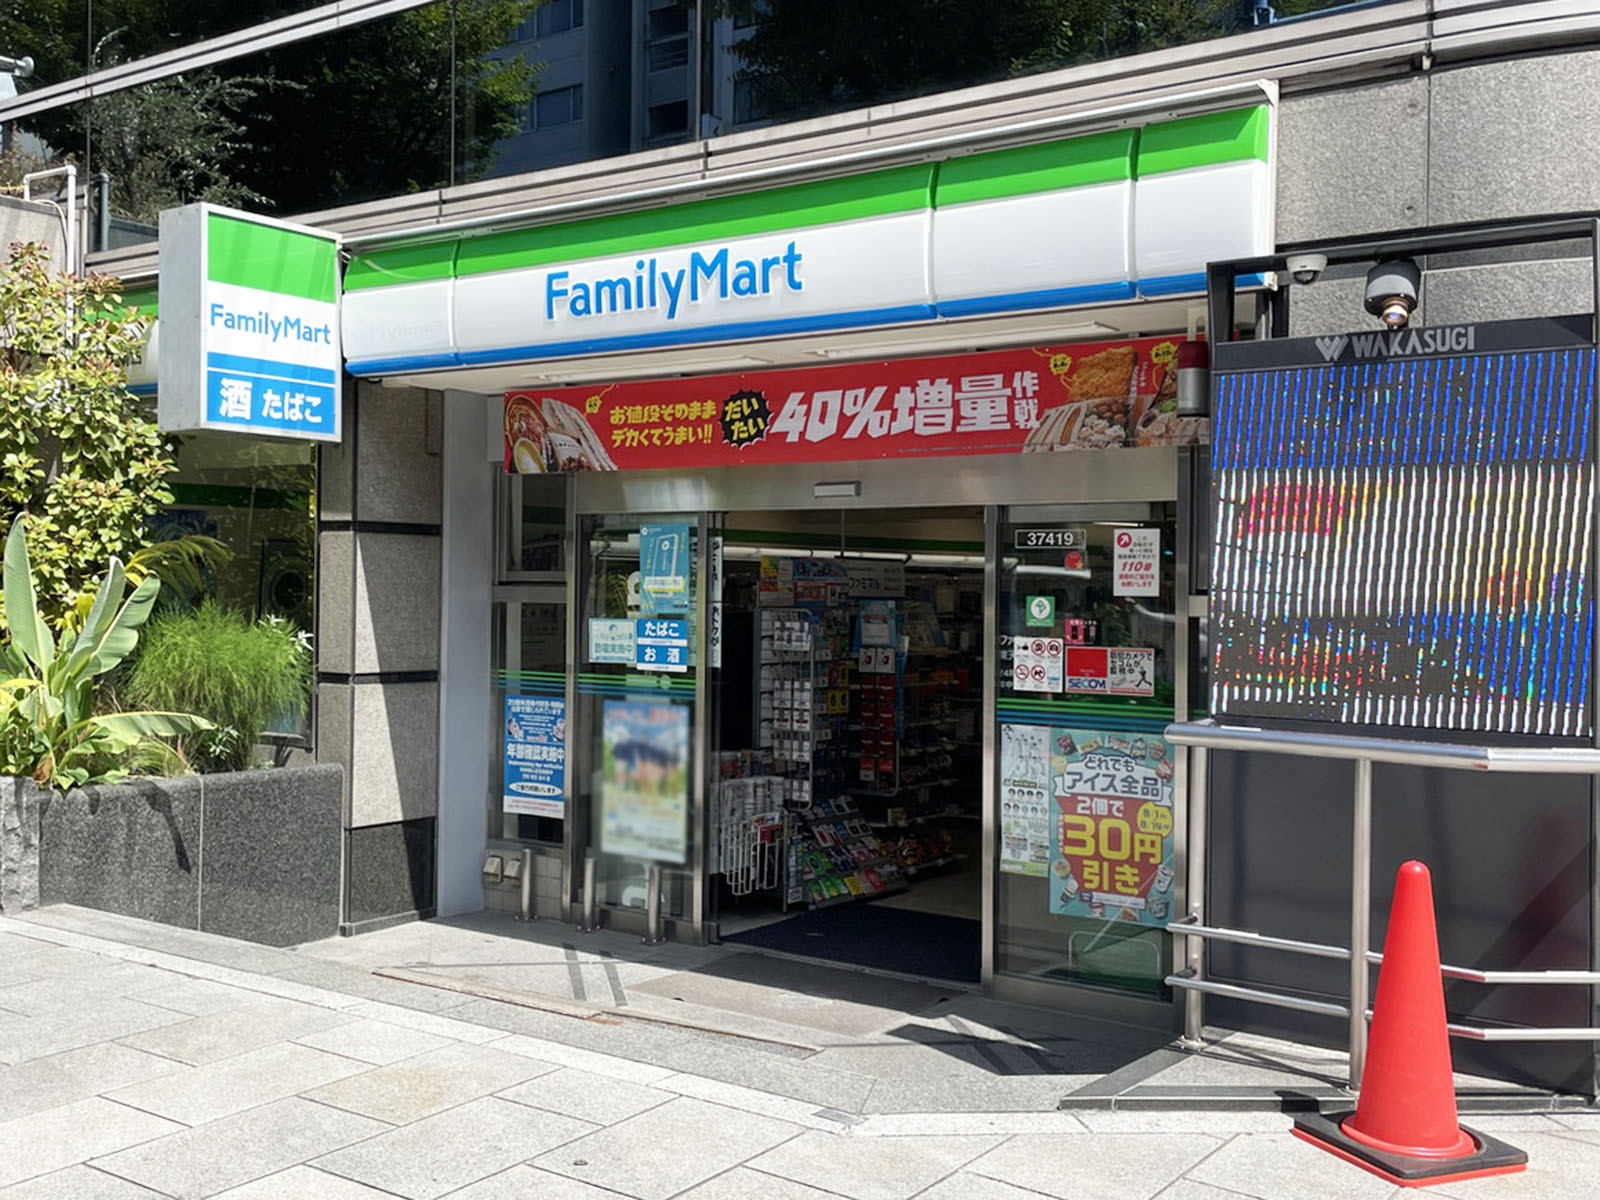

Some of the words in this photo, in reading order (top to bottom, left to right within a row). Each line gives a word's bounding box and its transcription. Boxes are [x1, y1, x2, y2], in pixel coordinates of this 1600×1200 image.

[547, 241, 802, 319] FamilyMart
[210, 303, 331, 345] FamilyMart
[1352, 326, 1475, 358] WAKASUGI
[219, 377, 253, 419] 酒
[262, 388, 322, 423] たばこ
[609, 400, 717, 425] お値段そのまま
[724, 397, 759, 422] だい
[770, 371, 1012, 443] 40%増量
[1013, 370, 1040, 430] 作戦
[731, 416, 765, 441] たい
[1027, 532, 1074, 546] 37419
[1122, 560, 1153, 571] 110番
[644, 621, 679, 637] たばこ
[644, 646, 680, 663] お酒
[1068, 678, 1106, 689] SECOM
[1084, 755, 1135, 772] どれでも
[1066, 771, 1160, 797] アイス全品
[1076, 796, 1125, 817] 2個で
[1063, 814, 1162, 864] 30円
[1082, 859, 1140, 895] 引き
